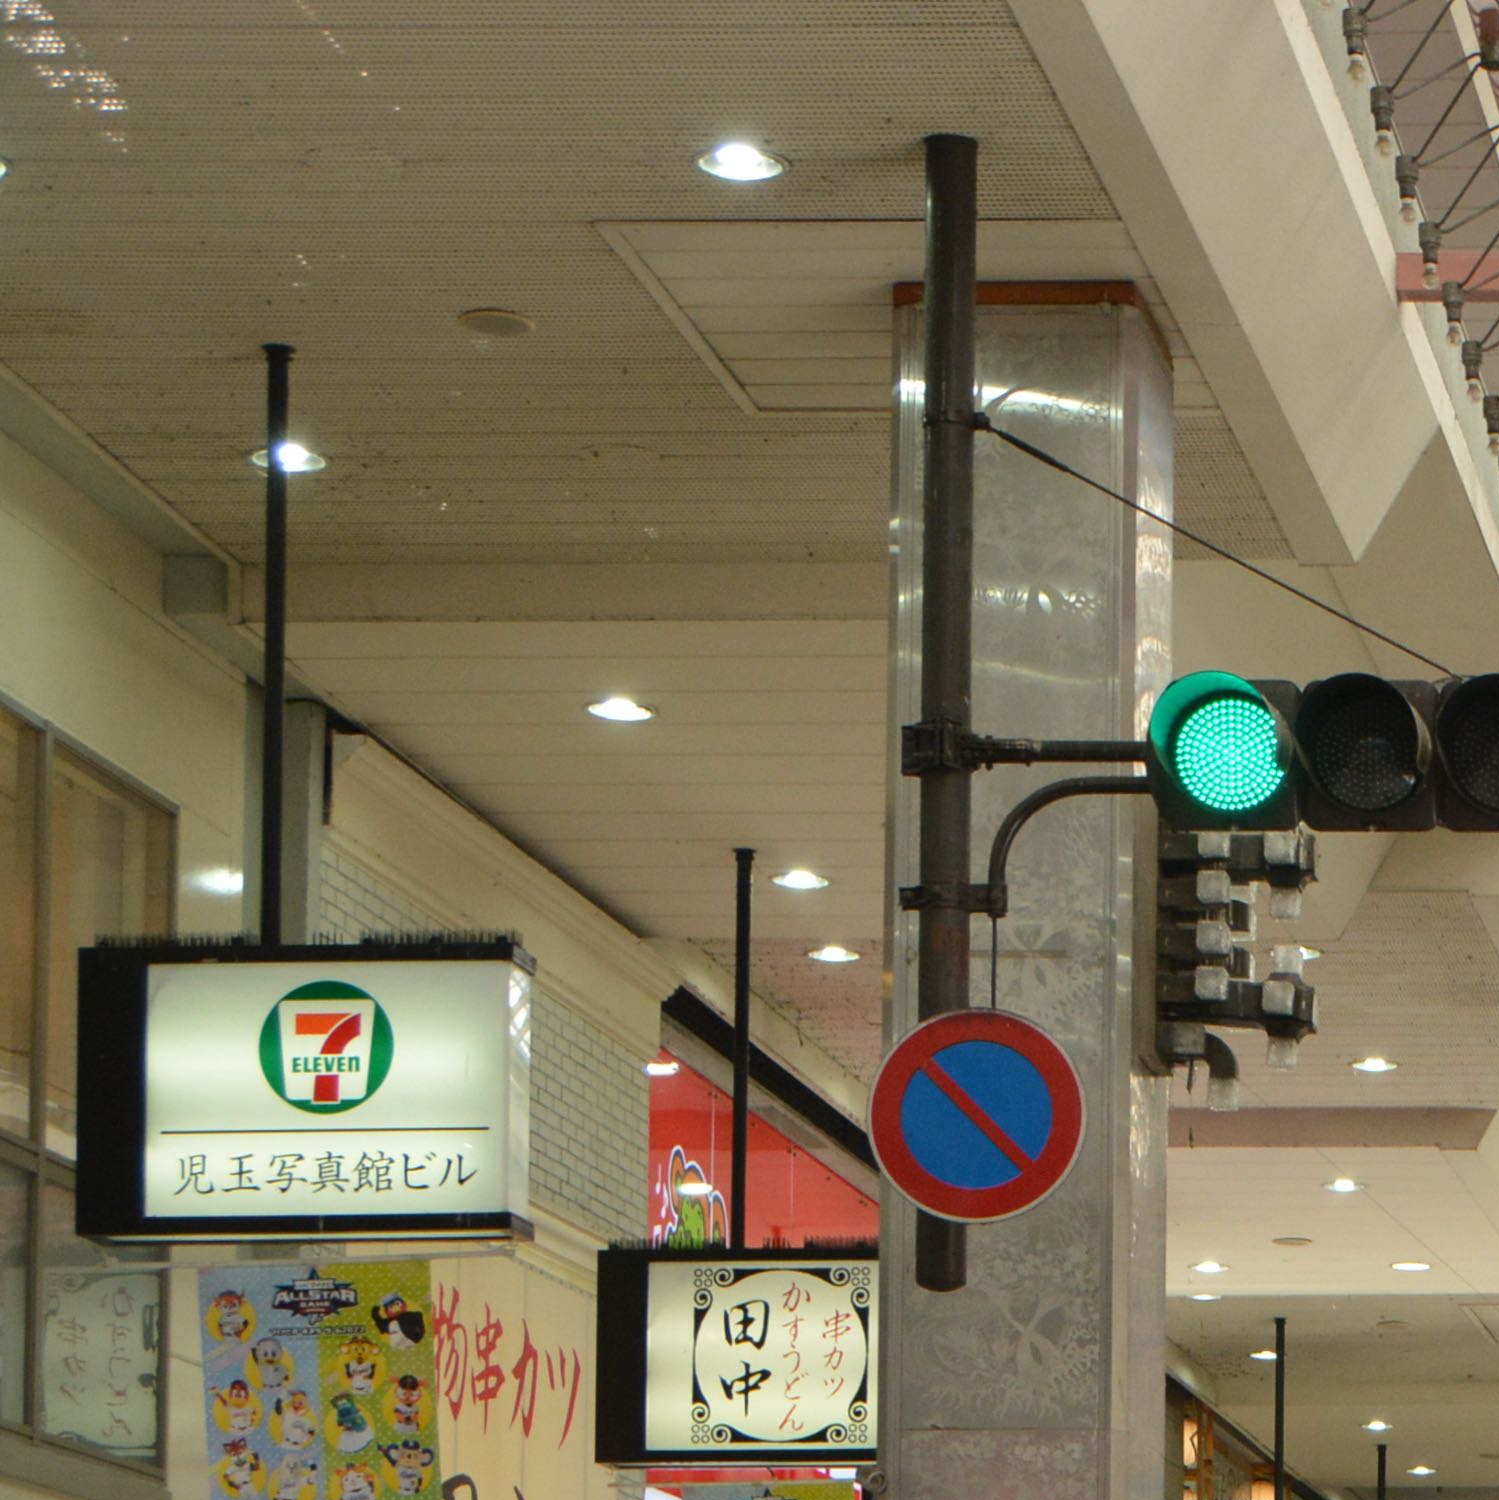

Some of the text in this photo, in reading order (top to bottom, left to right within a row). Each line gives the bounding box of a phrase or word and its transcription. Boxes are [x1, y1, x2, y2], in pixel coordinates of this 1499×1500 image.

[295, 1013, 361, 1103] 7
[173, 1152, 478, 1197] 児玉写真館ビル
[275, 1287, 357, 1307] ALLSTAR
[719, 1298, 773, 1418] 田中
[778, 1281, 812, 1432] かすうどん
[822, 1308, 852, 1400] 串カツ
